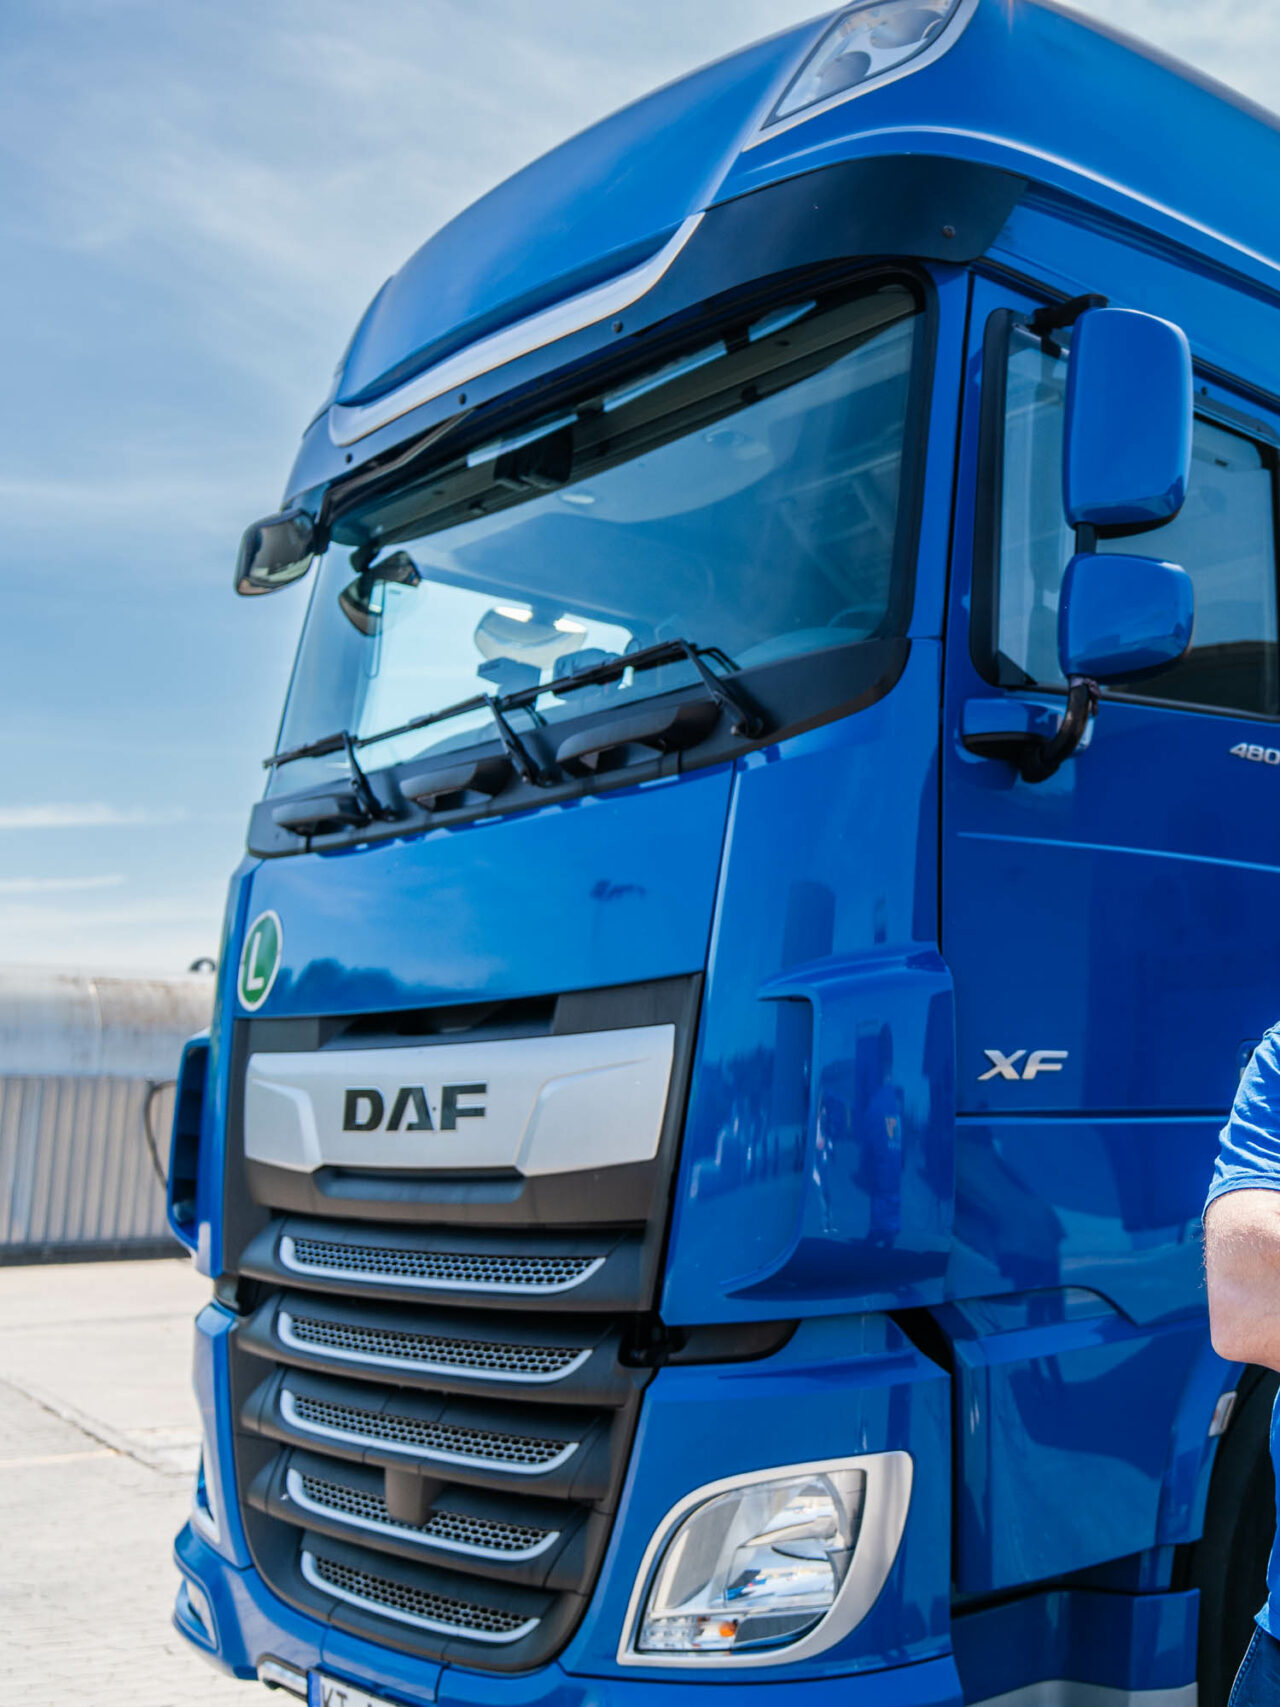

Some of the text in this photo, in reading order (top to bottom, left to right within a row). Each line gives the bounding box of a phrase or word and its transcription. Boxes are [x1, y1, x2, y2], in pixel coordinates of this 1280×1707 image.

[247, 931, 265, 991] L
[977, 1049, 1069, 1080] XF
[342, 1080, 488, 1132] DAF
